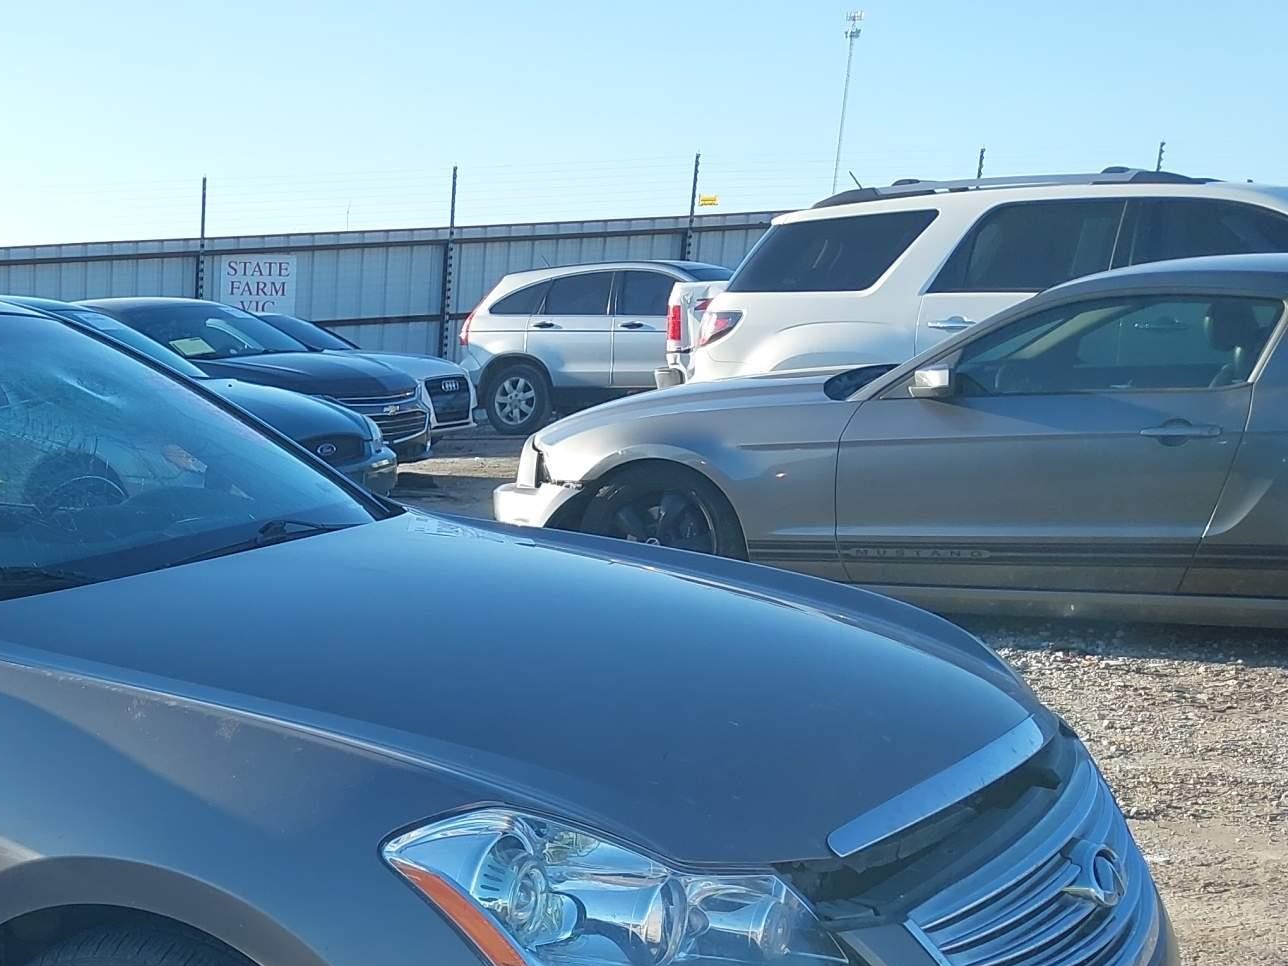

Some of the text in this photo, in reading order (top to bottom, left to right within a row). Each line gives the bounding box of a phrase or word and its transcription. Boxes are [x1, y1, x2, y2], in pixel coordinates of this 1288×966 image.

[227, 261, 290, 277] STATE
[230, 281, 286, 296] FARM
[854, 548, 984, 559] MUSTANG
